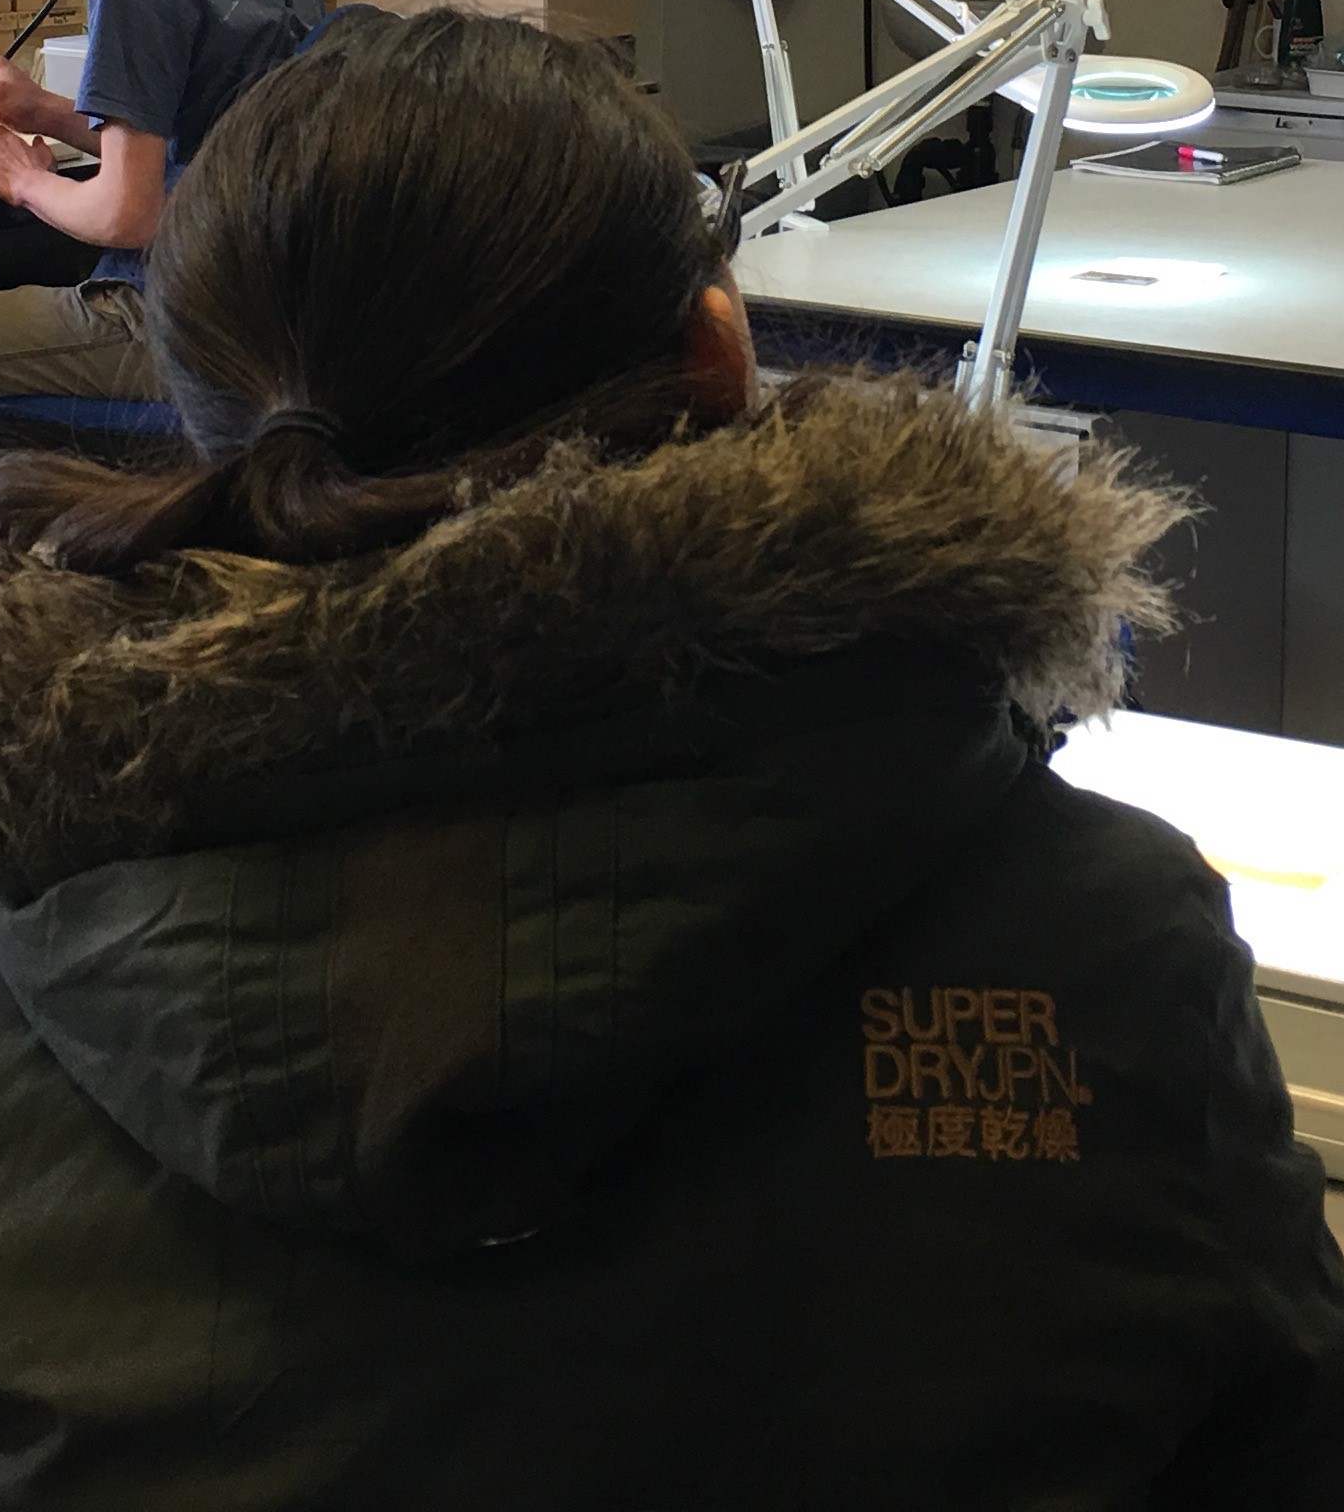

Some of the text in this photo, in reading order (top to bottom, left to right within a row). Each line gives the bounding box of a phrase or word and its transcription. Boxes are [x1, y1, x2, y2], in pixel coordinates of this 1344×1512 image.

[860, 986, 1060, 1047] SUPER
[866, 1103, 1081, 1163] 極度乾燥
